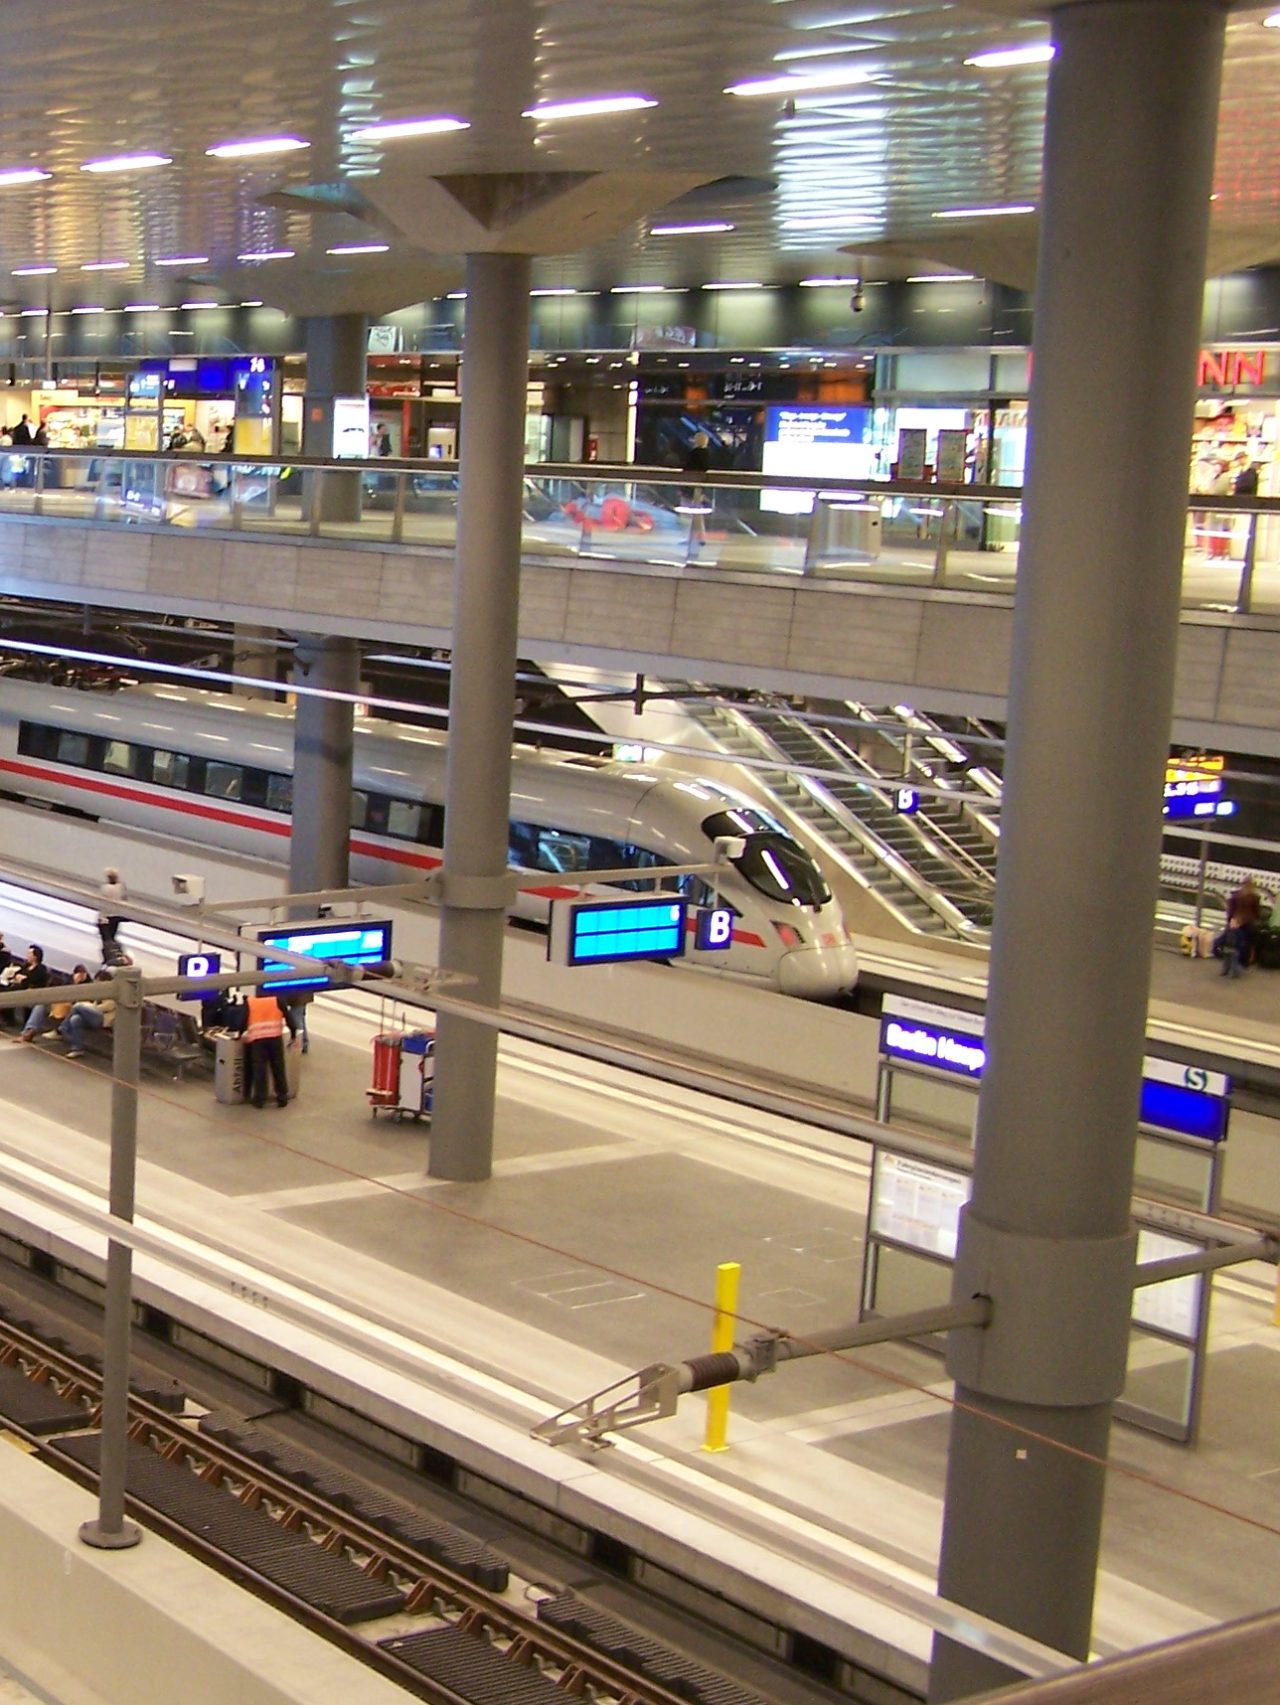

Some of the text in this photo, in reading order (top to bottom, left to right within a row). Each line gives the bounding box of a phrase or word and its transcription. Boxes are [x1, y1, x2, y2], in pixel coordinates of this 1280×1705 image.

[898, 789, 914, 809] B
[709, 910, 731, 944] B
[886, 1022, 938, 1057] Berlin
[1185, 1066, 1207, 1092] S
